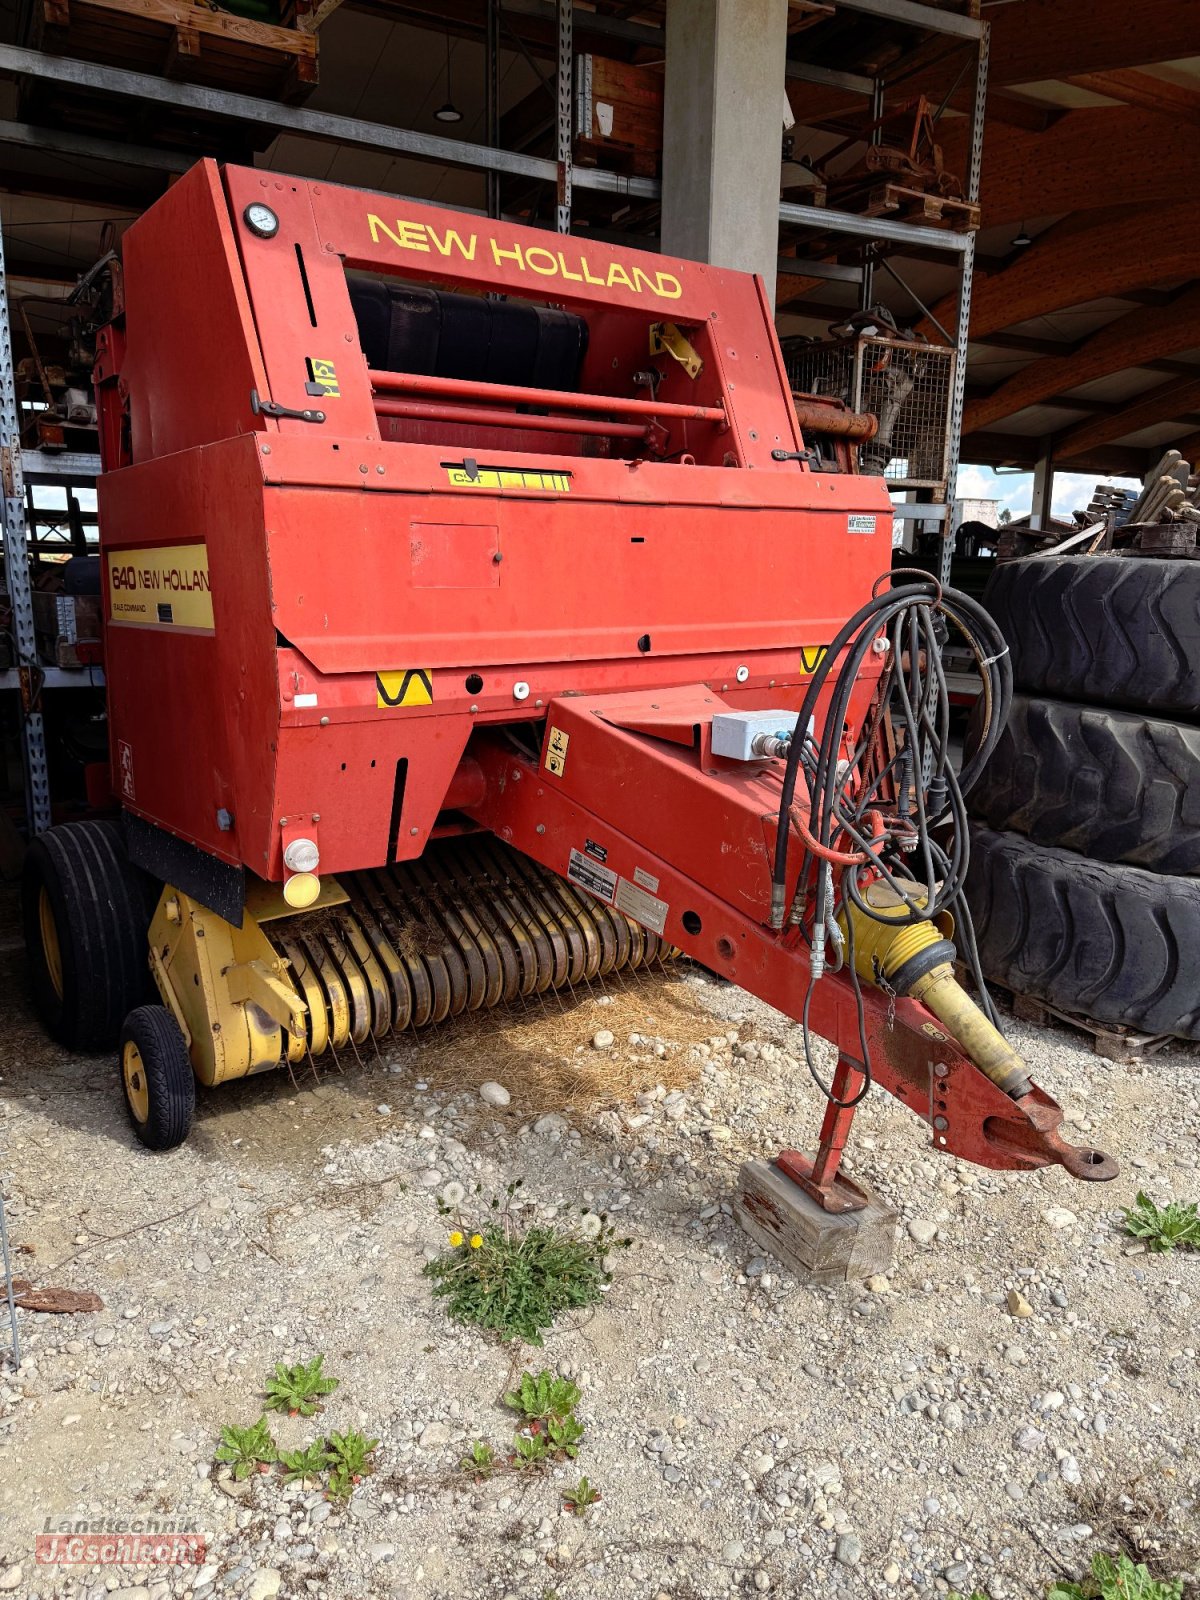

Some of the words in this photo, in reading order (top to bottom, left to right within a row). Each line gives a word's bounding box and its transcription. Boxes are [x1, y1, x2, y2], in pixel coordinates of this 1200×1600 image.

[366, 213, 477, 260] NEW
[490, 238, 682, 299] HOLLAND
[112, 566, 137, 590] 640
[138, 569, 160, 590] NEW
[162, 569, 211, 592] HOLLAN
